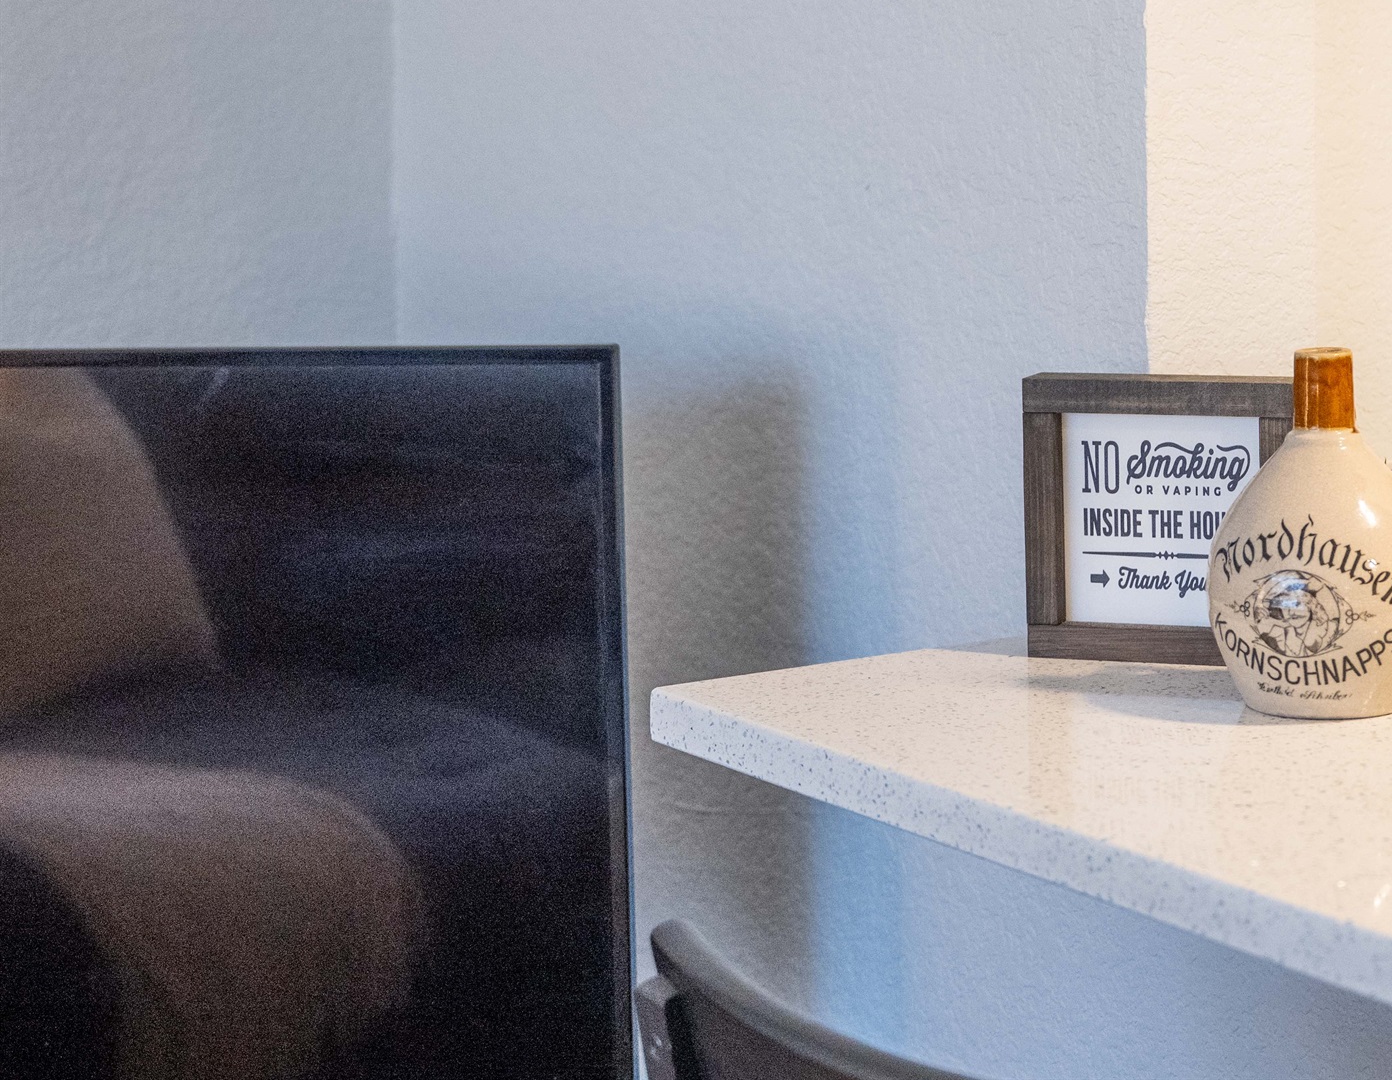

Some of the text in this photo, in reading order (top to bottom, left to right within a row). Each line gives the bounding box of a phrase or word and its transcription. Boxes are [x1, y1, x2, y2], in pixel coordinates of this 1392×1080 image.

[1081, 439, 1251, 494] NO Smoking
[1134, 485, 1222, 497] OR VAPING
[1082, 507, 1143, 538] INSIDE
[1148, 509, 1184, 539] THE
[1118, 565, 1208, 599] Thank You
